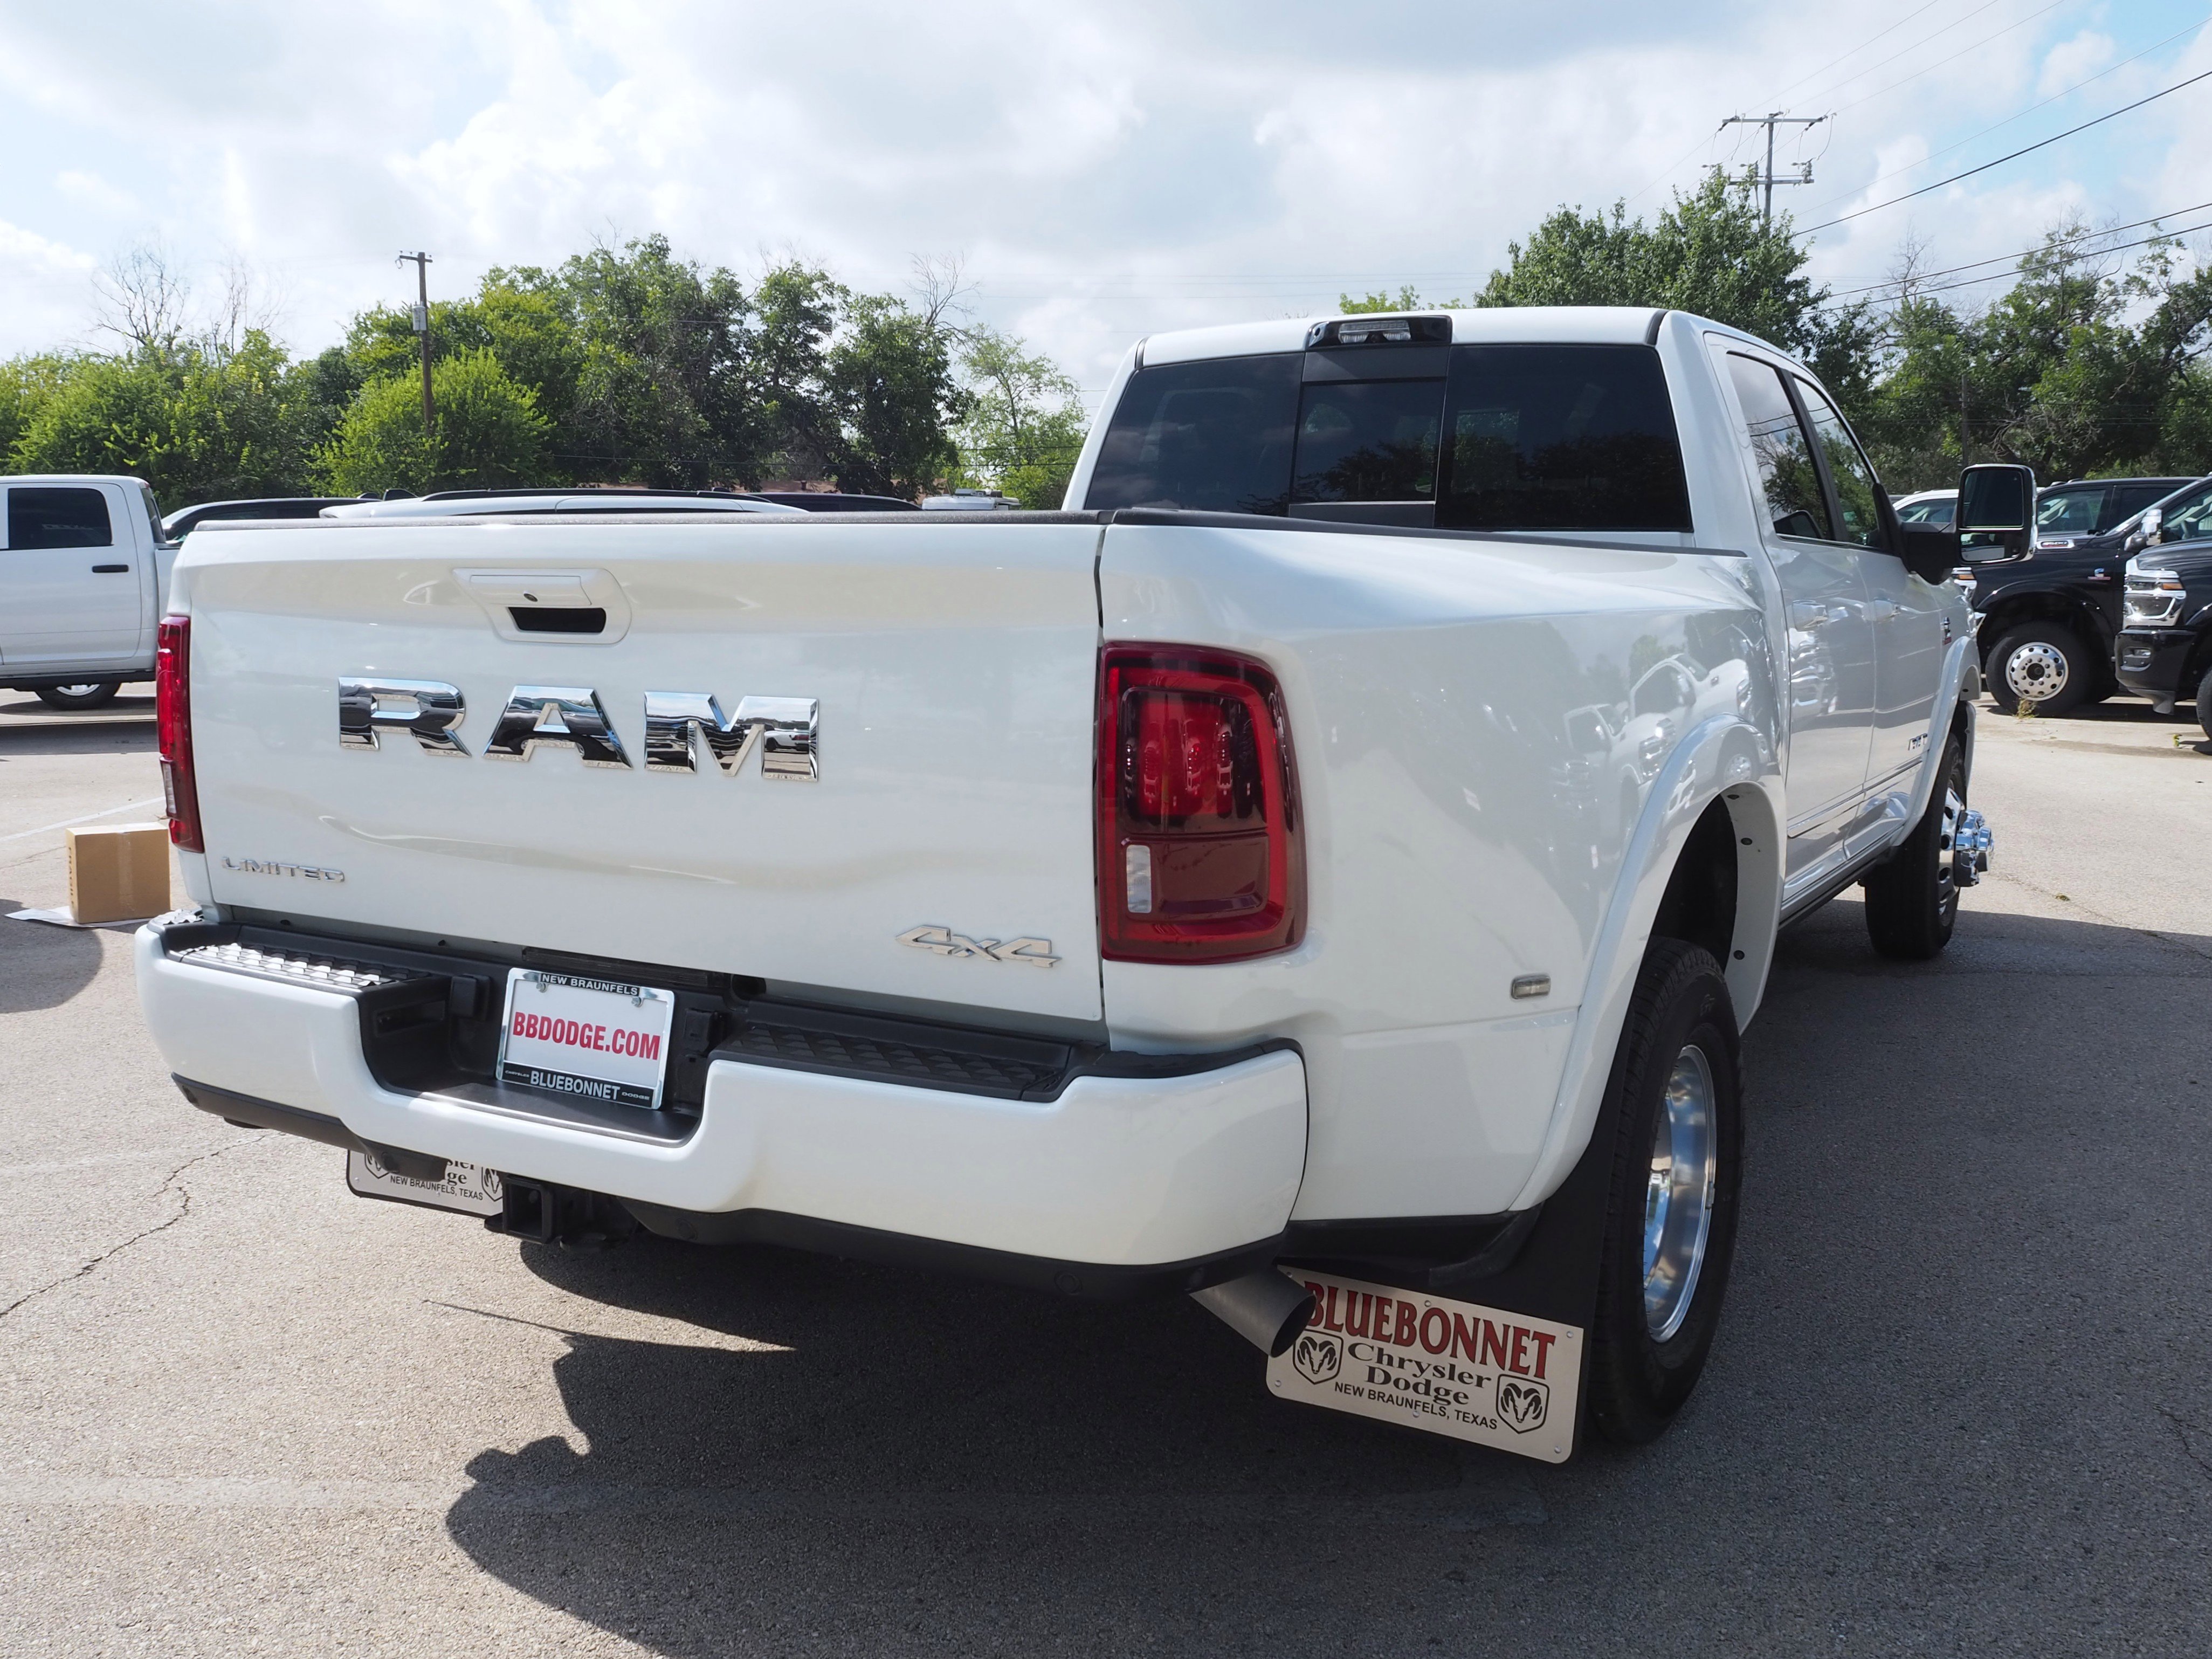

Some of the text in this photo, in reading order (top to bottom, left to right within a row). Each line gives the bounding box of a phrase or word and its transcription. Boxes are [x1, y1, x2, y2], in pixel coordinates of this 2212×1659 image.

[339, 677, 819, 782] RAM
[221, 856, 345, 883] LIMITED
[542, 974, 638, 996] NEW BRAUNFELS
[513, 1011, 661, 1061] BBDODGE.COM
[530, 1070, 621, 1100] BLUEBONNET
[622, 1092, 650, 1100] DODGE
[390, 1175, 408, 1186] NEW
[410, 1178, 457, 1196] BRAUNFELS,
[459, 1188, 484, 1201] TEXAS
[1348, 1342, 1492, 1388] Chrysler
[1365, 1365, 1470, 1406] Dodge
[1334, 1382, 1498, 1429] NEW BRAUNFELS, TEXAS
